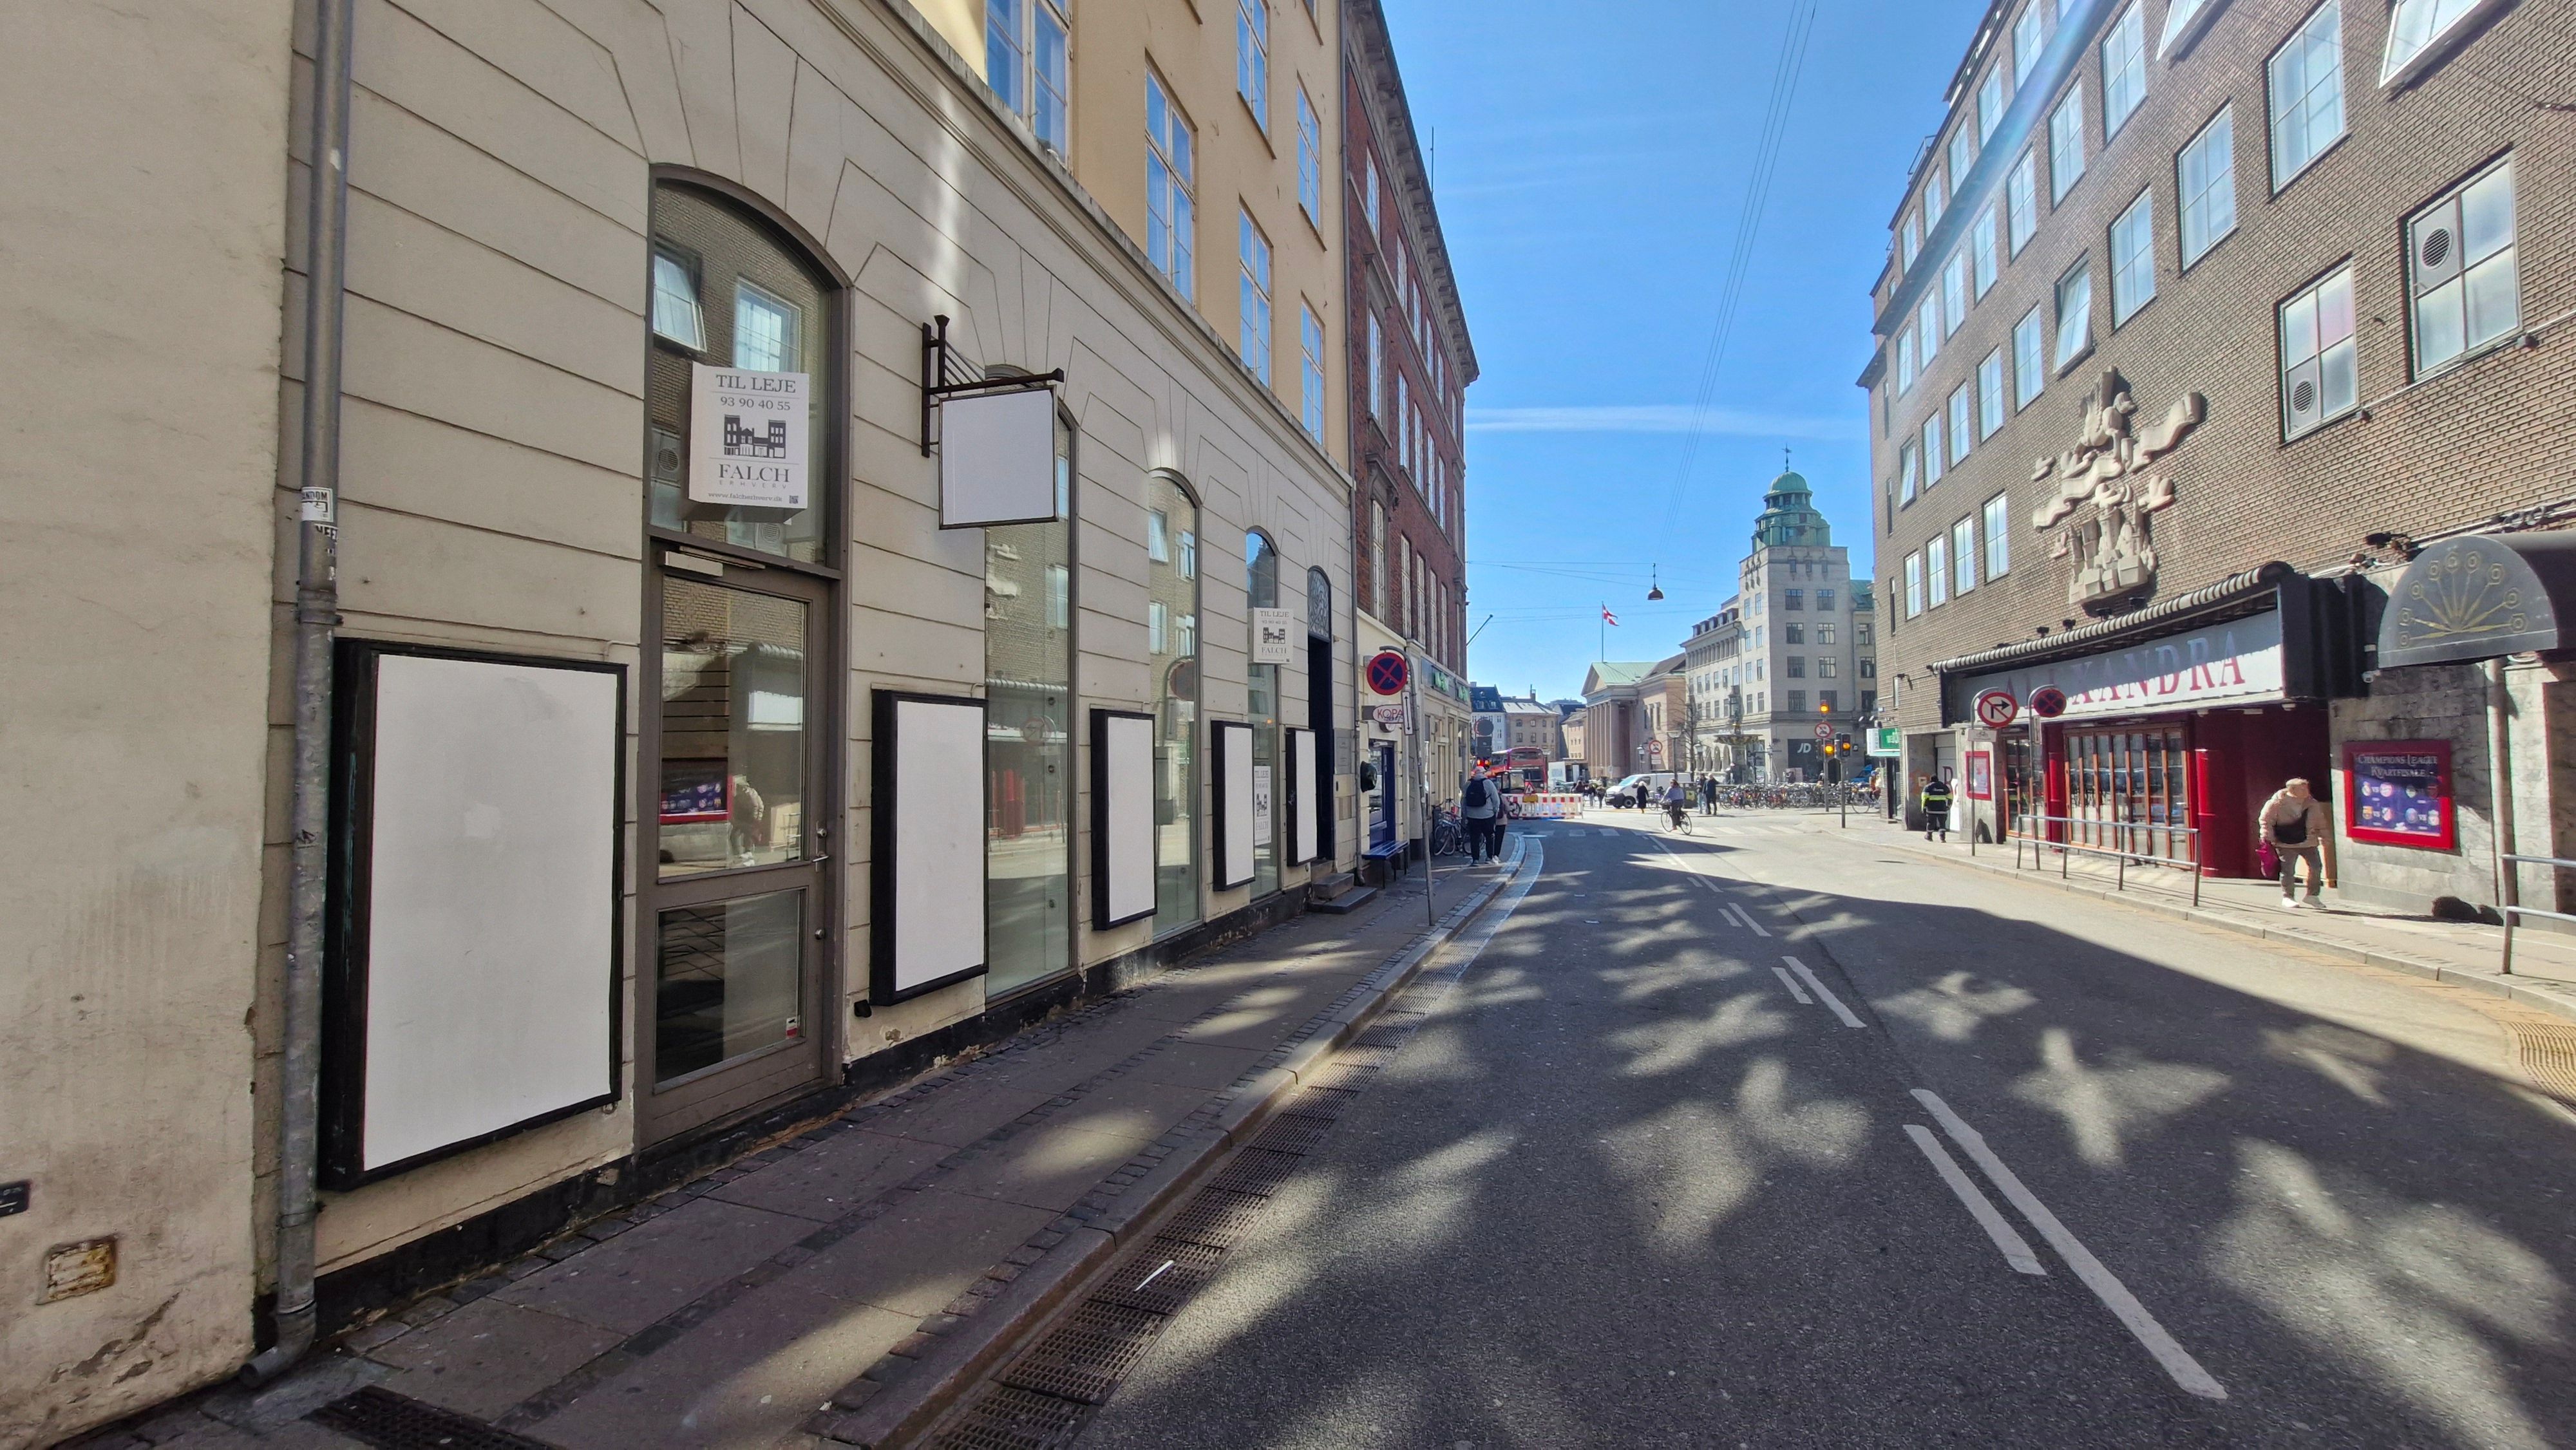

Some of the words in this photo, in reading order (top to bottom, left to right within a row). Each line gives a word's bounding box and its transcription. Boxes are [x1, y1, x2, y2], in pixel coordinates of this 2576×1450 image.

[716, 374, 746, 390] TIL
[751, 377, 796, 393] LEJE
[721, 396, 735, 407] 93
[739, 399, 754, 408] 90
[759, 400, 773, 410] 40
[777, 400, 791, 411] 55
[719, 464, 790, 483] FALCH
[1797, 742, 1812, 753] JD
